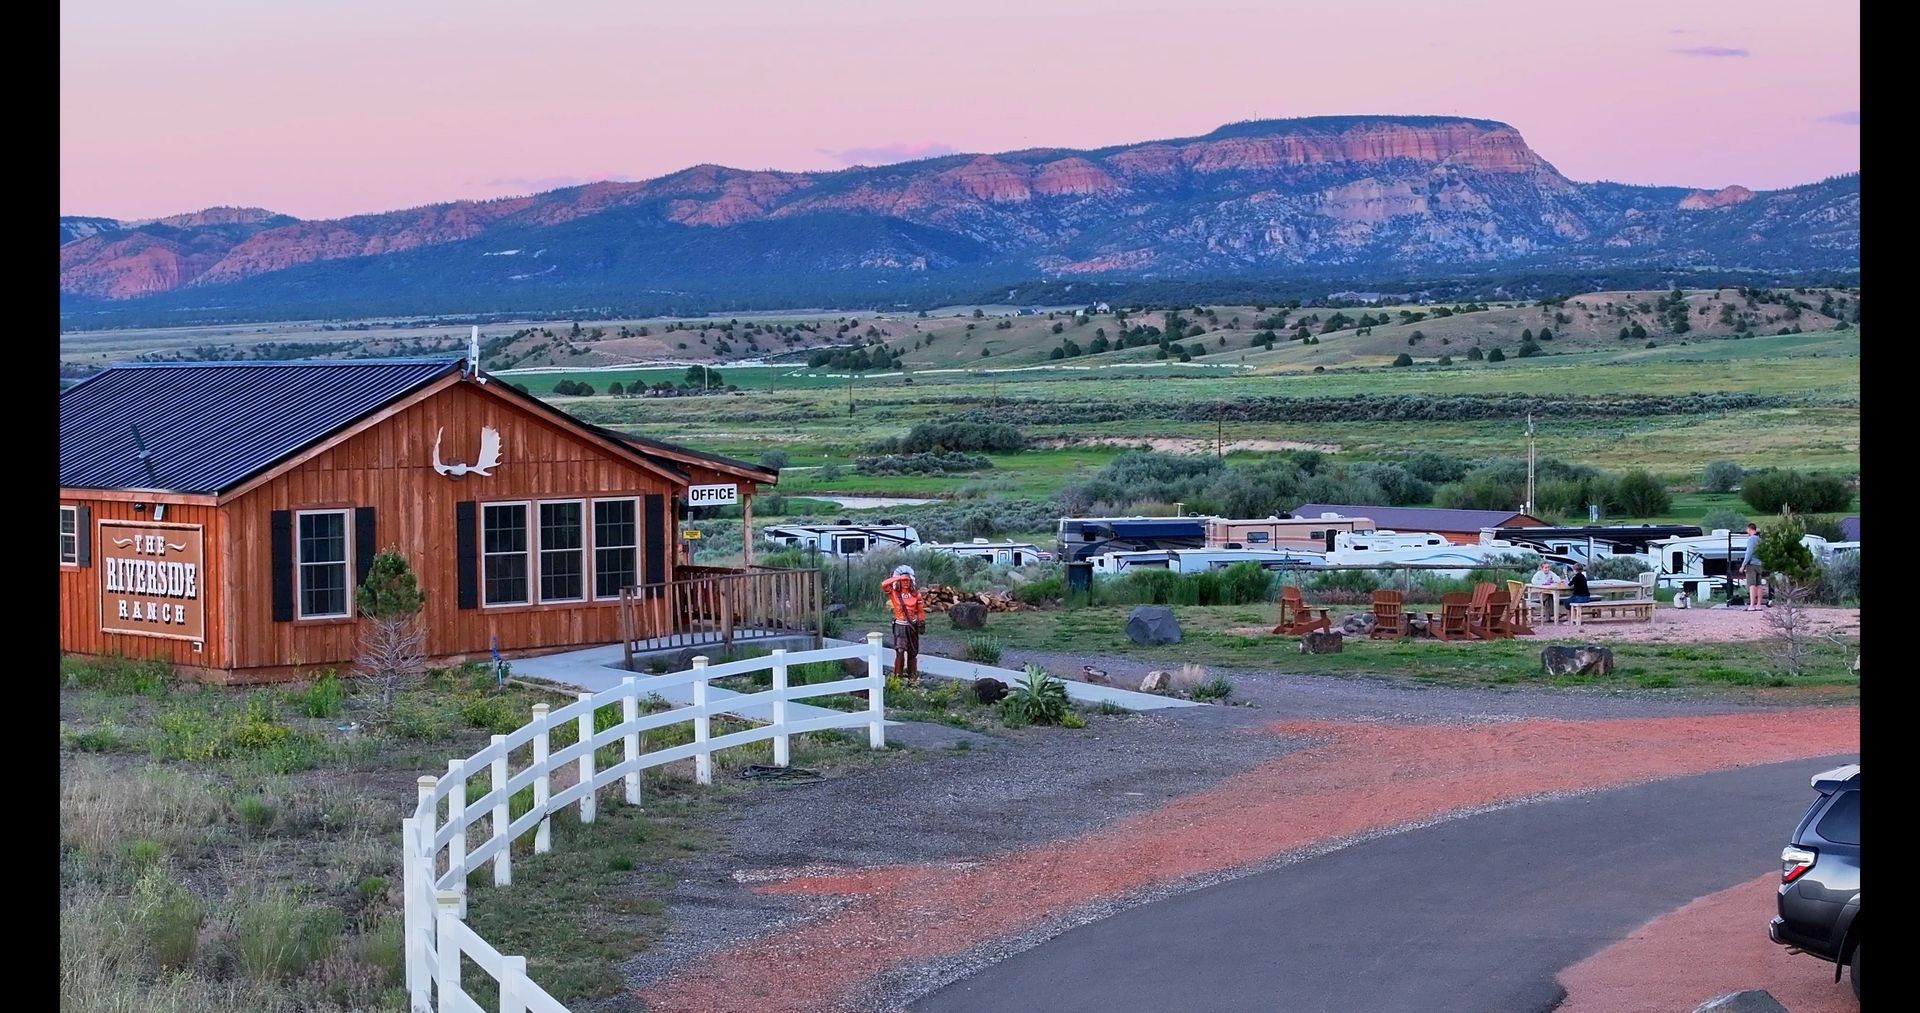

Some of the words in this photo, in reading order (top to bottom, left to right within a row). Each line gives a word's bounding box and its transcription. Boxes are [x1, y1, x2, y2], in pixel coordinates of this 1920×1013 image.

[691, 488, 735, 501] OFFICE
[134, 534, 166, 554] THE
[106, 557, 197, 598] RIVERSIDE
[118, 600, 186, 623] RANCH
